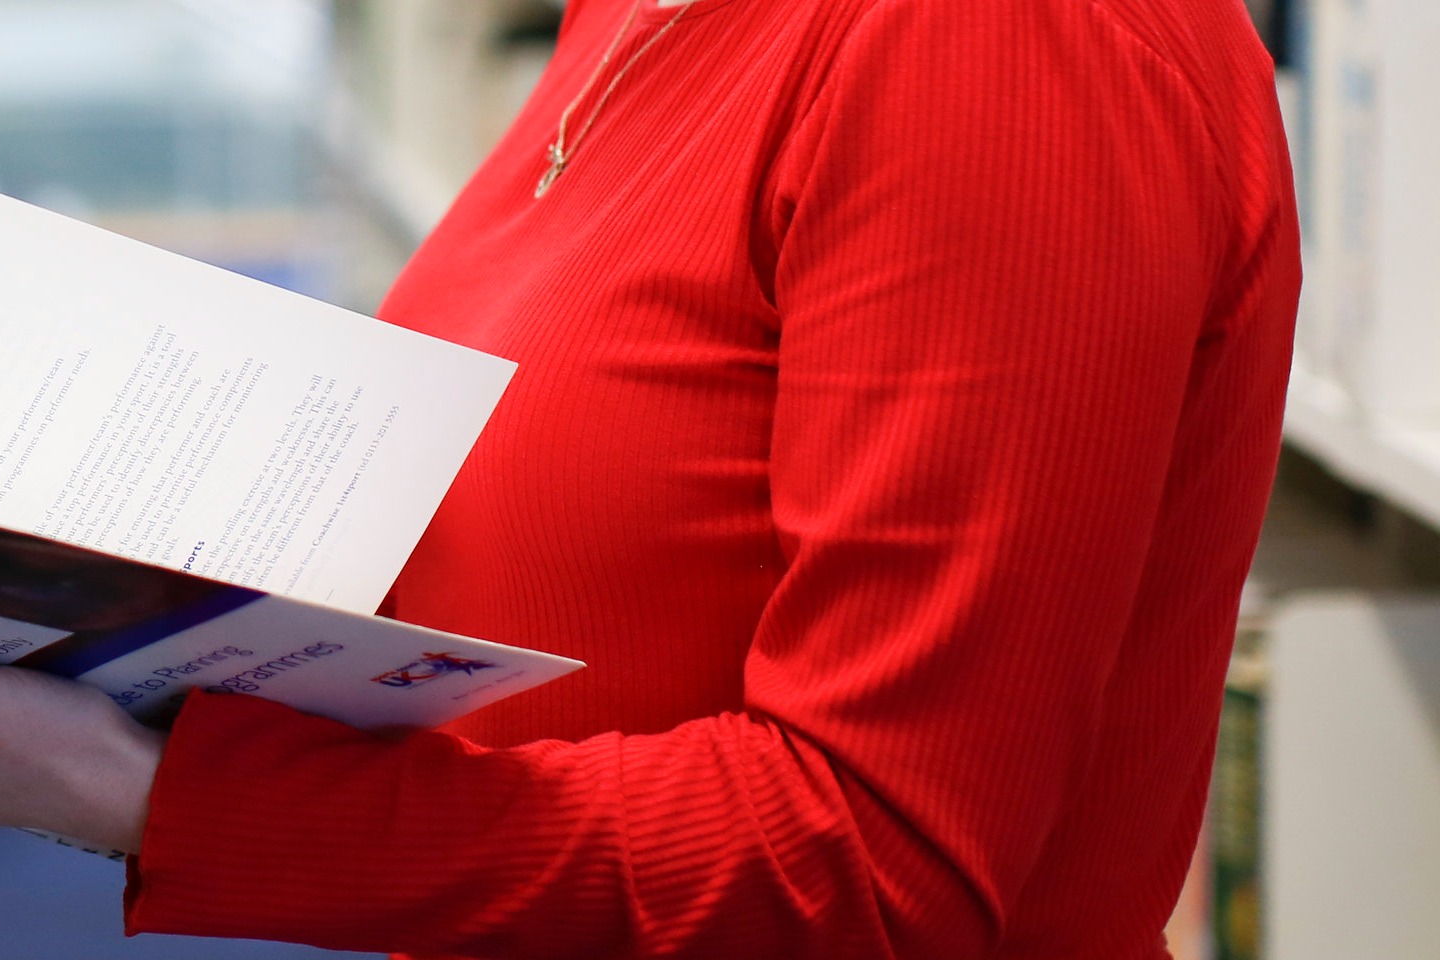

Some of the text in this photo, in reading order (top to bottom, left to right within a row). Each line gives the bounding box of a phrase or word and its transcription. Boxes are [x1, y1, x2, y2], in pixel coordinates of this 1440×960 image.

[2, 431, 20, 454] your
[17, 357, 65, 432] performers/team
[3, 348, 92, 491] programmes performer needs.
[50, 324, 169, 512] your performer/team's performance against
[65, 332, 177, 513] top performance your sport. tool
[74, 348, 185, 527] performers' perceptions their strengths
[94, 376, 202, 548] perceptions they are performing.
[97, 493, 115, 515] used
[114, 448, 144, 483] identify
[136, 389, 177, 448] discrepancies
[169, 350, 200, 389] between
[130, 494, 159, 532] ensuring
[151, 475, 169, 494] that
[164, 429, 195, 476] performer
[192, 410, 206, 430] and
[202, 385, 222, 411] coach
[140, 357, 254, 541] used prioritise performance components
[145, 362, 270, 559] and useful mechanism for monitoring
[218, 374, 323, 546] profiling exercise levels. They will
[247, 485, 275, 524] strengths
[271, 467, 285, 485] and
[280, 417, 315, 467] weaknesses.
[161, 536, 181, 561] goals.
[234, 416, 331, 570] are same wavelength and share
[251, 413, 349, 566] the team's perceptions their ability
[255, 421, 360, 587] often different from that the coach.
[132, 678, 166, 691] to
[153, 645, 254, 680] Planning
